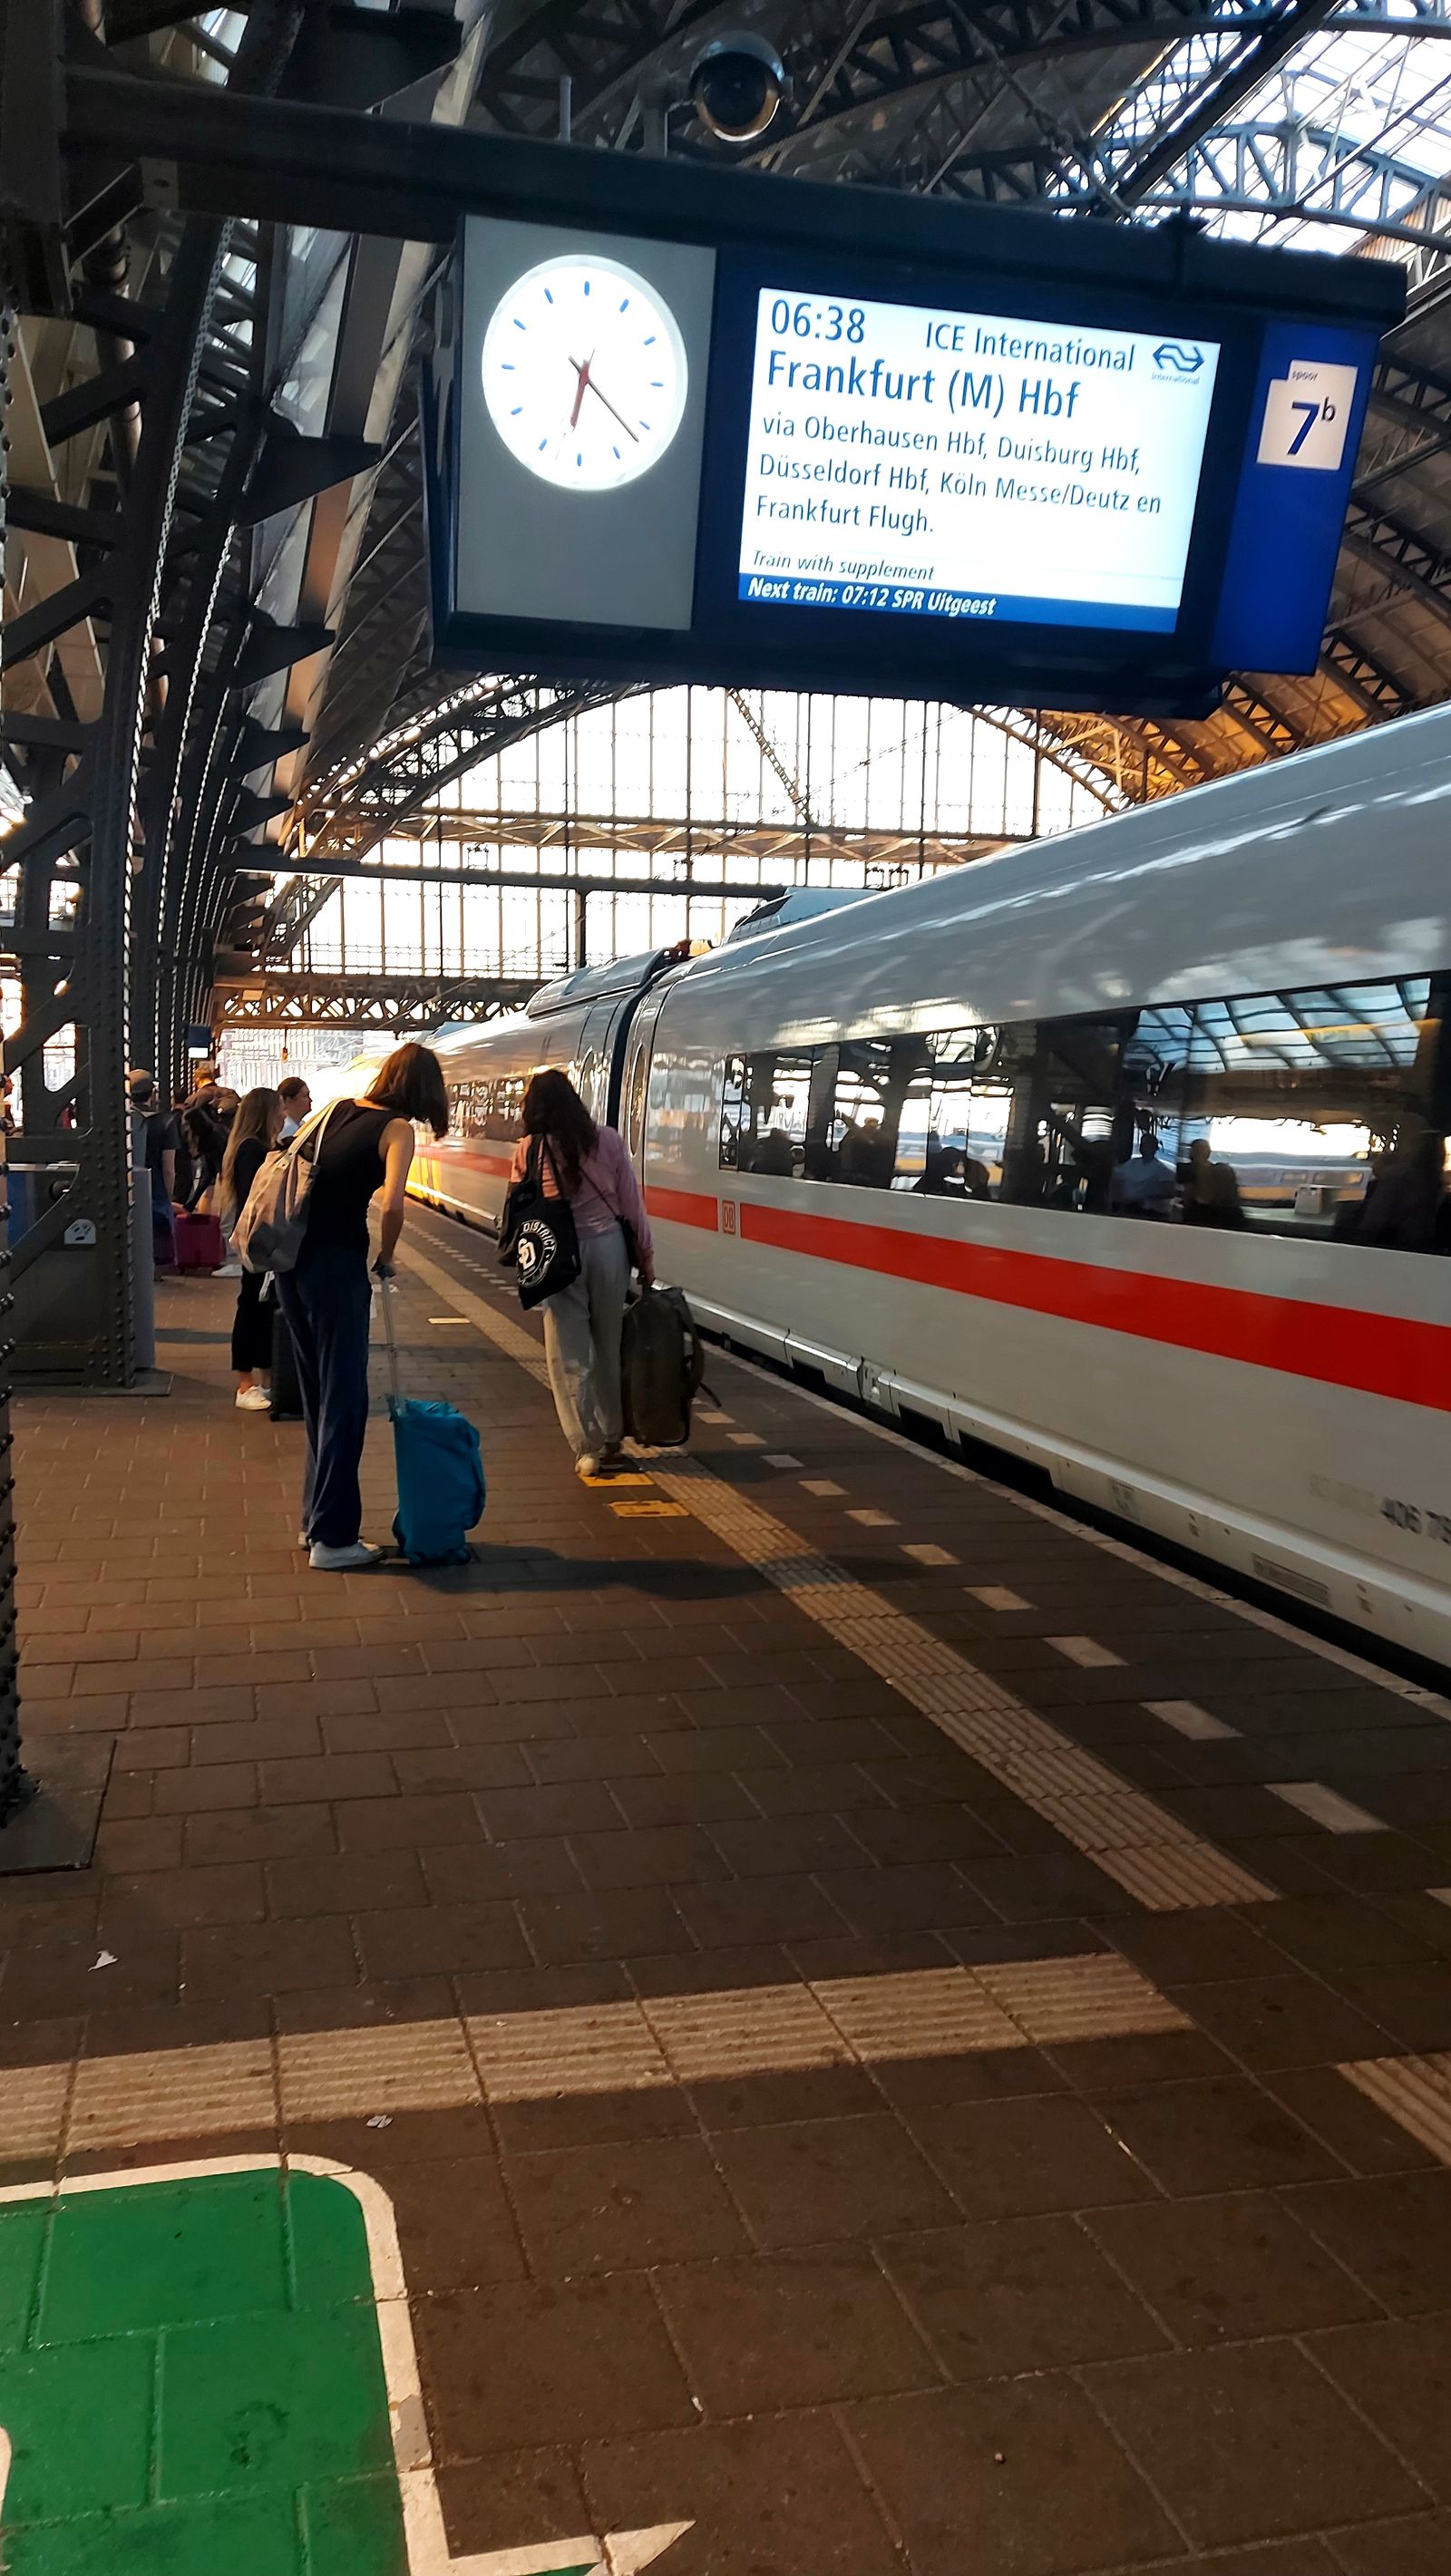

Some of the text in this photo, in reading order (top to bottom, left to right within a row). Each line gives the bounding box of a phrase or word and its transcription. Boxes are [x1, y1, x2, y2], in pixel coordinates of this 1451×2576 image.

[771, 299, 866, 344] 06:38
[926, 321, 1135, 372] ICE International
[768, 349, 1081, 419] Frankfurt (M) Hbf
[763, 411, 1141, 476] via Oberhausen Hbf, Duisburg Hbf,
[760, 452, 1162, 514] Düsseldorf Hbf, Köln Messe/Deutz en
[756, 494, 934, 537] Frankfurt Flugh.
[754, 549, 935, 581] Train with supplement
[747, 577, 997, 617] Next train: 07:12 SPR Uitgeest
[522, 1221, 556, 1251] DISTRICT
